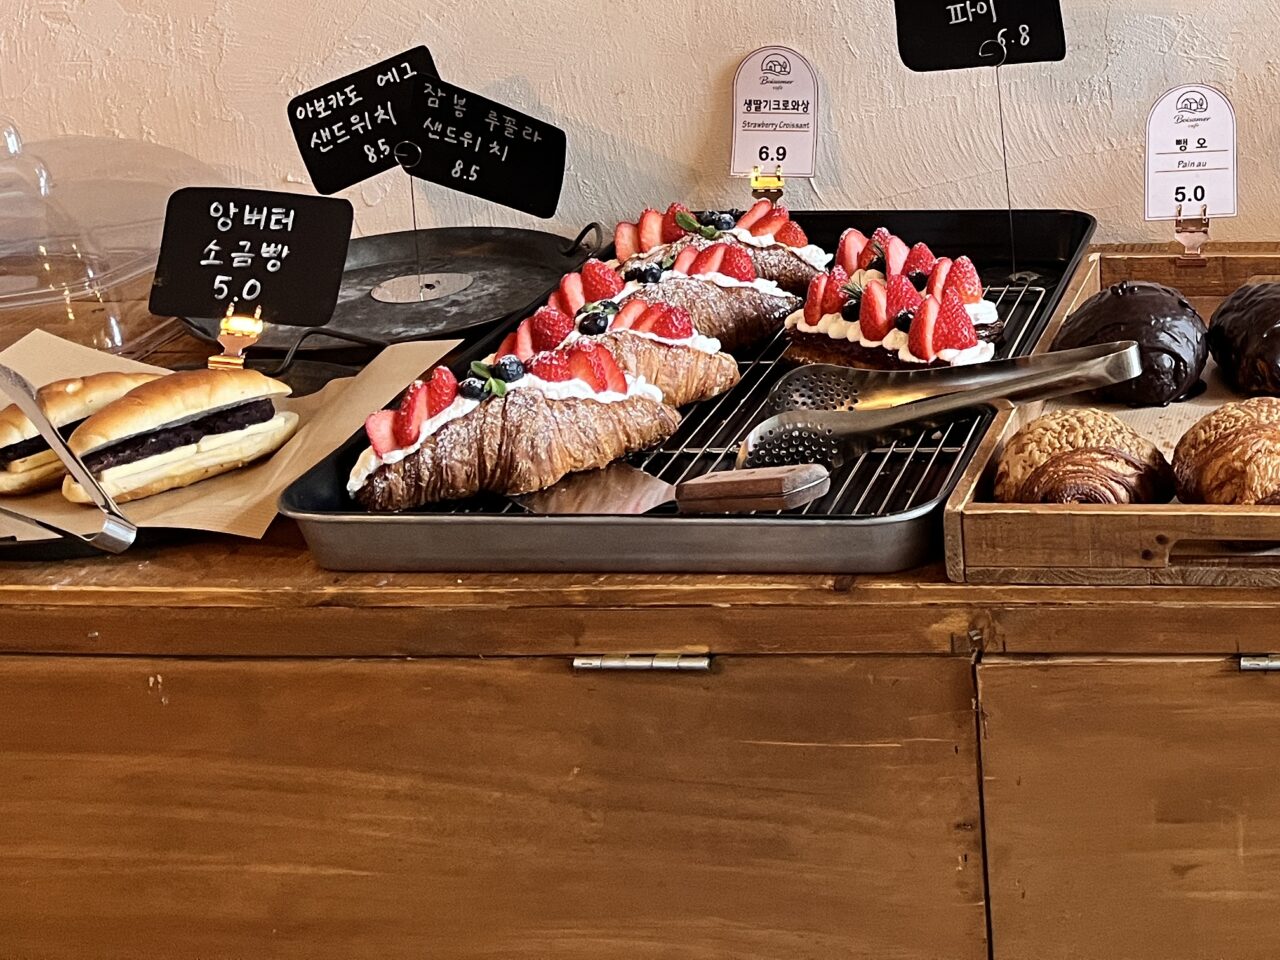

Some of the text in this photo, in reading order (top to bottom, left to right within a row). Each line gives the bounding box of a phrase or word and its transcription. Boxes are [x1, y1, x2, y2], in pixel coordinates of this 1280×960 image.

[946, 0, 997, 24] 파이
[997, 24, 1030, 46] 6.8
[296, 62, 417, 120] 아보카도 에그
[743, 99, 810, 113] 생딸기크로와상
[310, 101, 397, 153] 샌드위치
[742, 120, 810, 131] Strawberry Croissant
[364, 139, 390, 163] 8.5
[423, 117, 508, 162] 샌드위치
[759, 146, 787, 161] 6.9
[1177, 160, 1195, 168] Pain
[451, 160, 480, 182] 8.5
[1174, 185, 1205, 202] 5.0
[210, 202, 295, 231] 앙버터
[200, 240, 290, 272] 소금빵
[213, 275, 261, 302] 5.0
